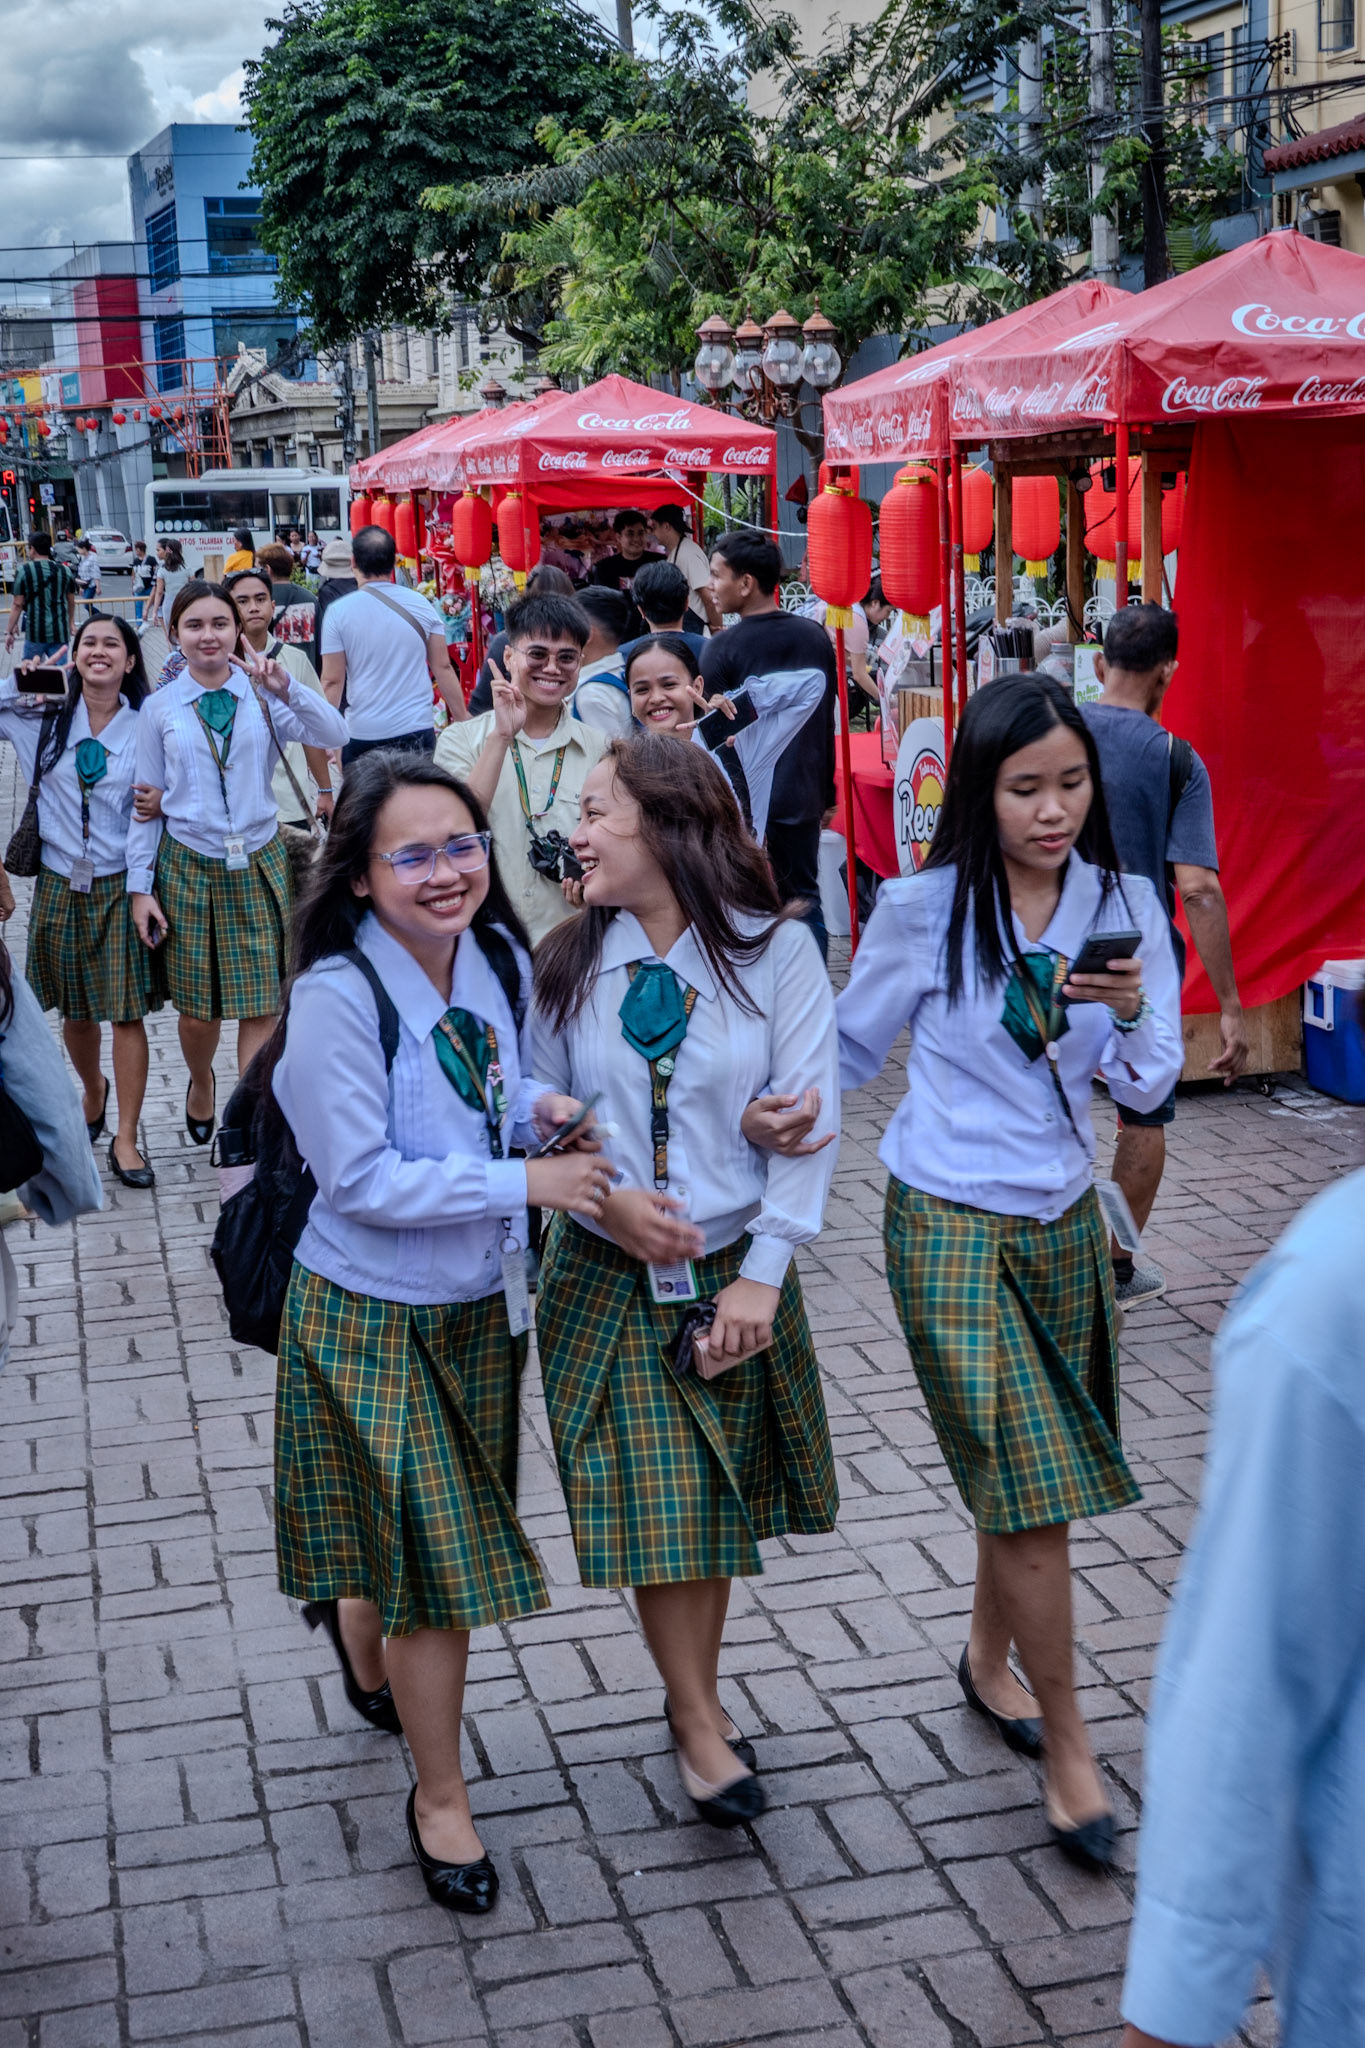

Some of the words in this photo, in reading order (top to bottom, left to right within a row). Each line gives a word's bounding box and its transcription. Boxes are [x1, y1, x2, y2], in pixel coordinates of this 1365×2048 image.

[1161, 376, 1268, 414] Coca-Cola
[577, 407, 691, 431] Coca-Cola
[538, 450, 589, 471] Coca-Cola
[600, 448, 652, 468] Coca-Cola
[663, 446, 714, 466] Coca-Cola
[722, 445, 772, 465] Coca-Cola
